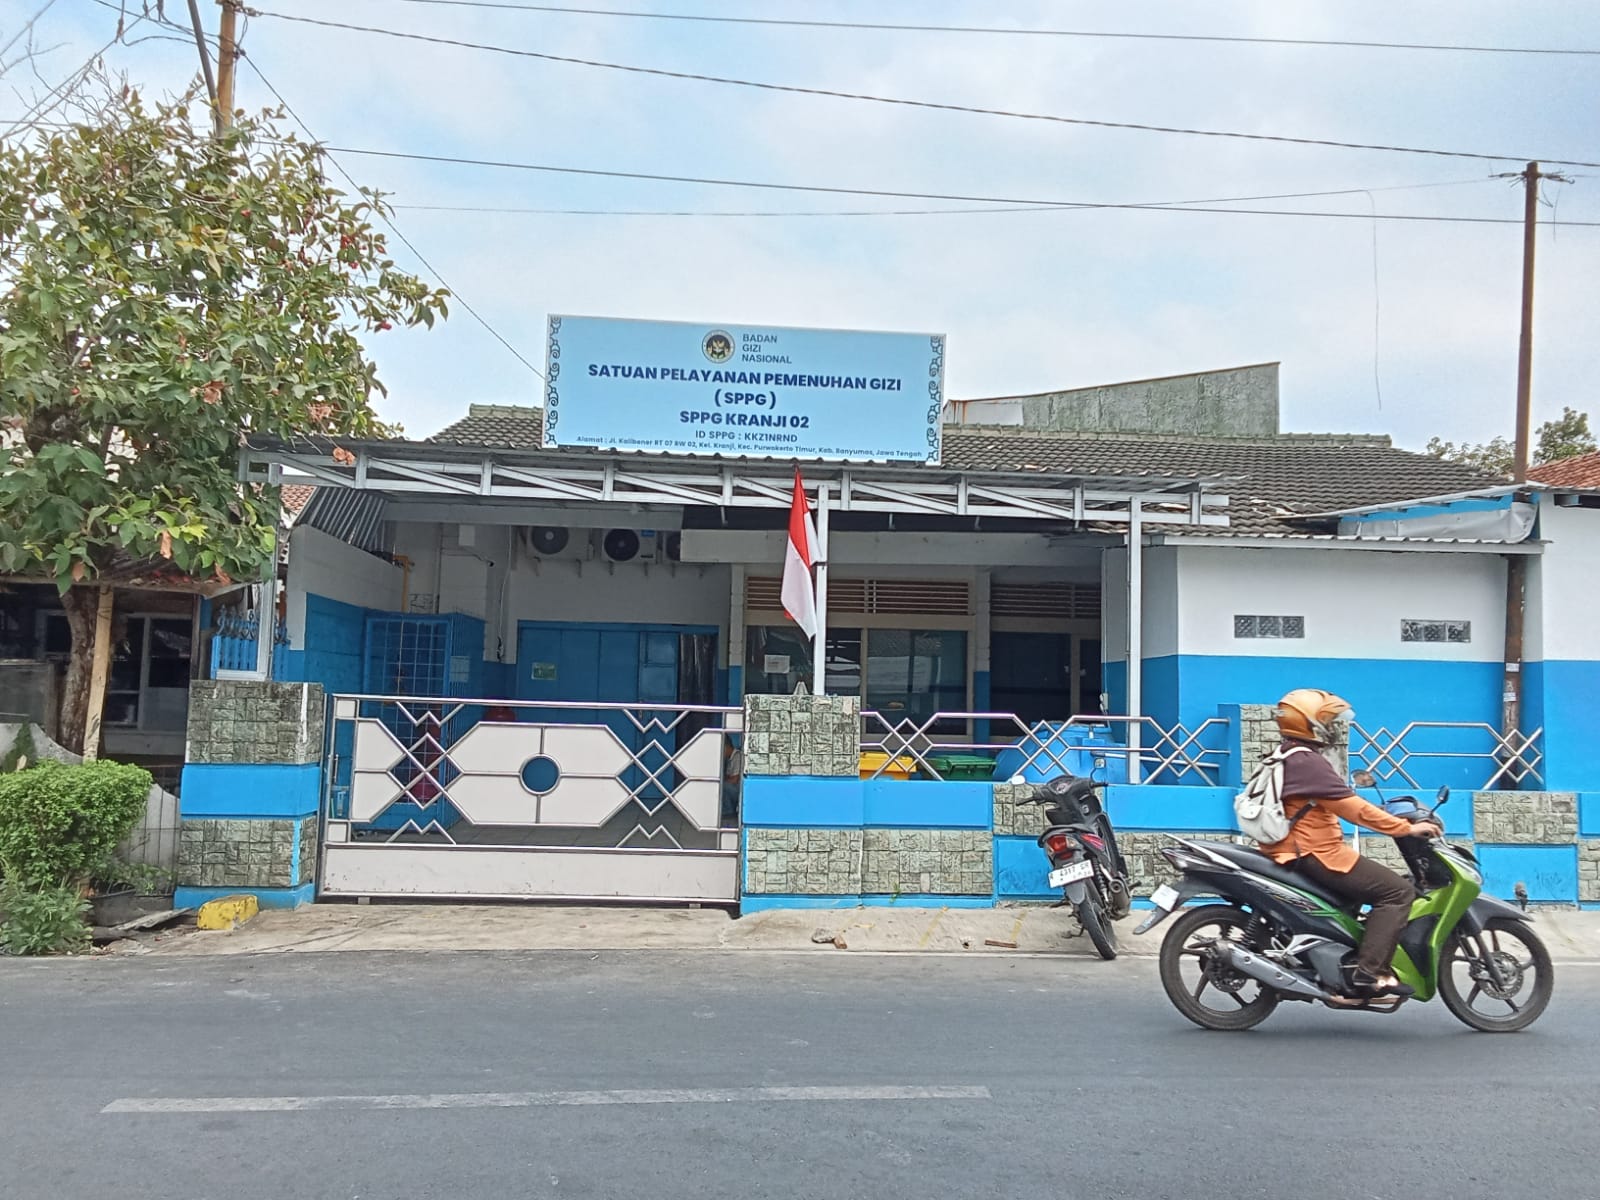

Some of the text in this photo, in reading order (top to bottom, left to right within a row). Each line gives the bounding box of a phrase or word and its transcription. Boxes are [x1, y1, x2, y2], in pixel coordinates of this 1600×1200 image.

[742, 333, 778, 343] BADAN
[742, 343, 761, 352] GIZI
[741, 354, 792, 364] NASIONAL
[588, 364, 901, 391] SATUAN PELAYANAN PEMENUHAN GIZI
[679, 411, 809, 428] SPPG KRANJI 02
[695, 430, 706, 438] ID
[709, 431, 736, 439] SPPG
[896, 450, 922, 458] Tengah
